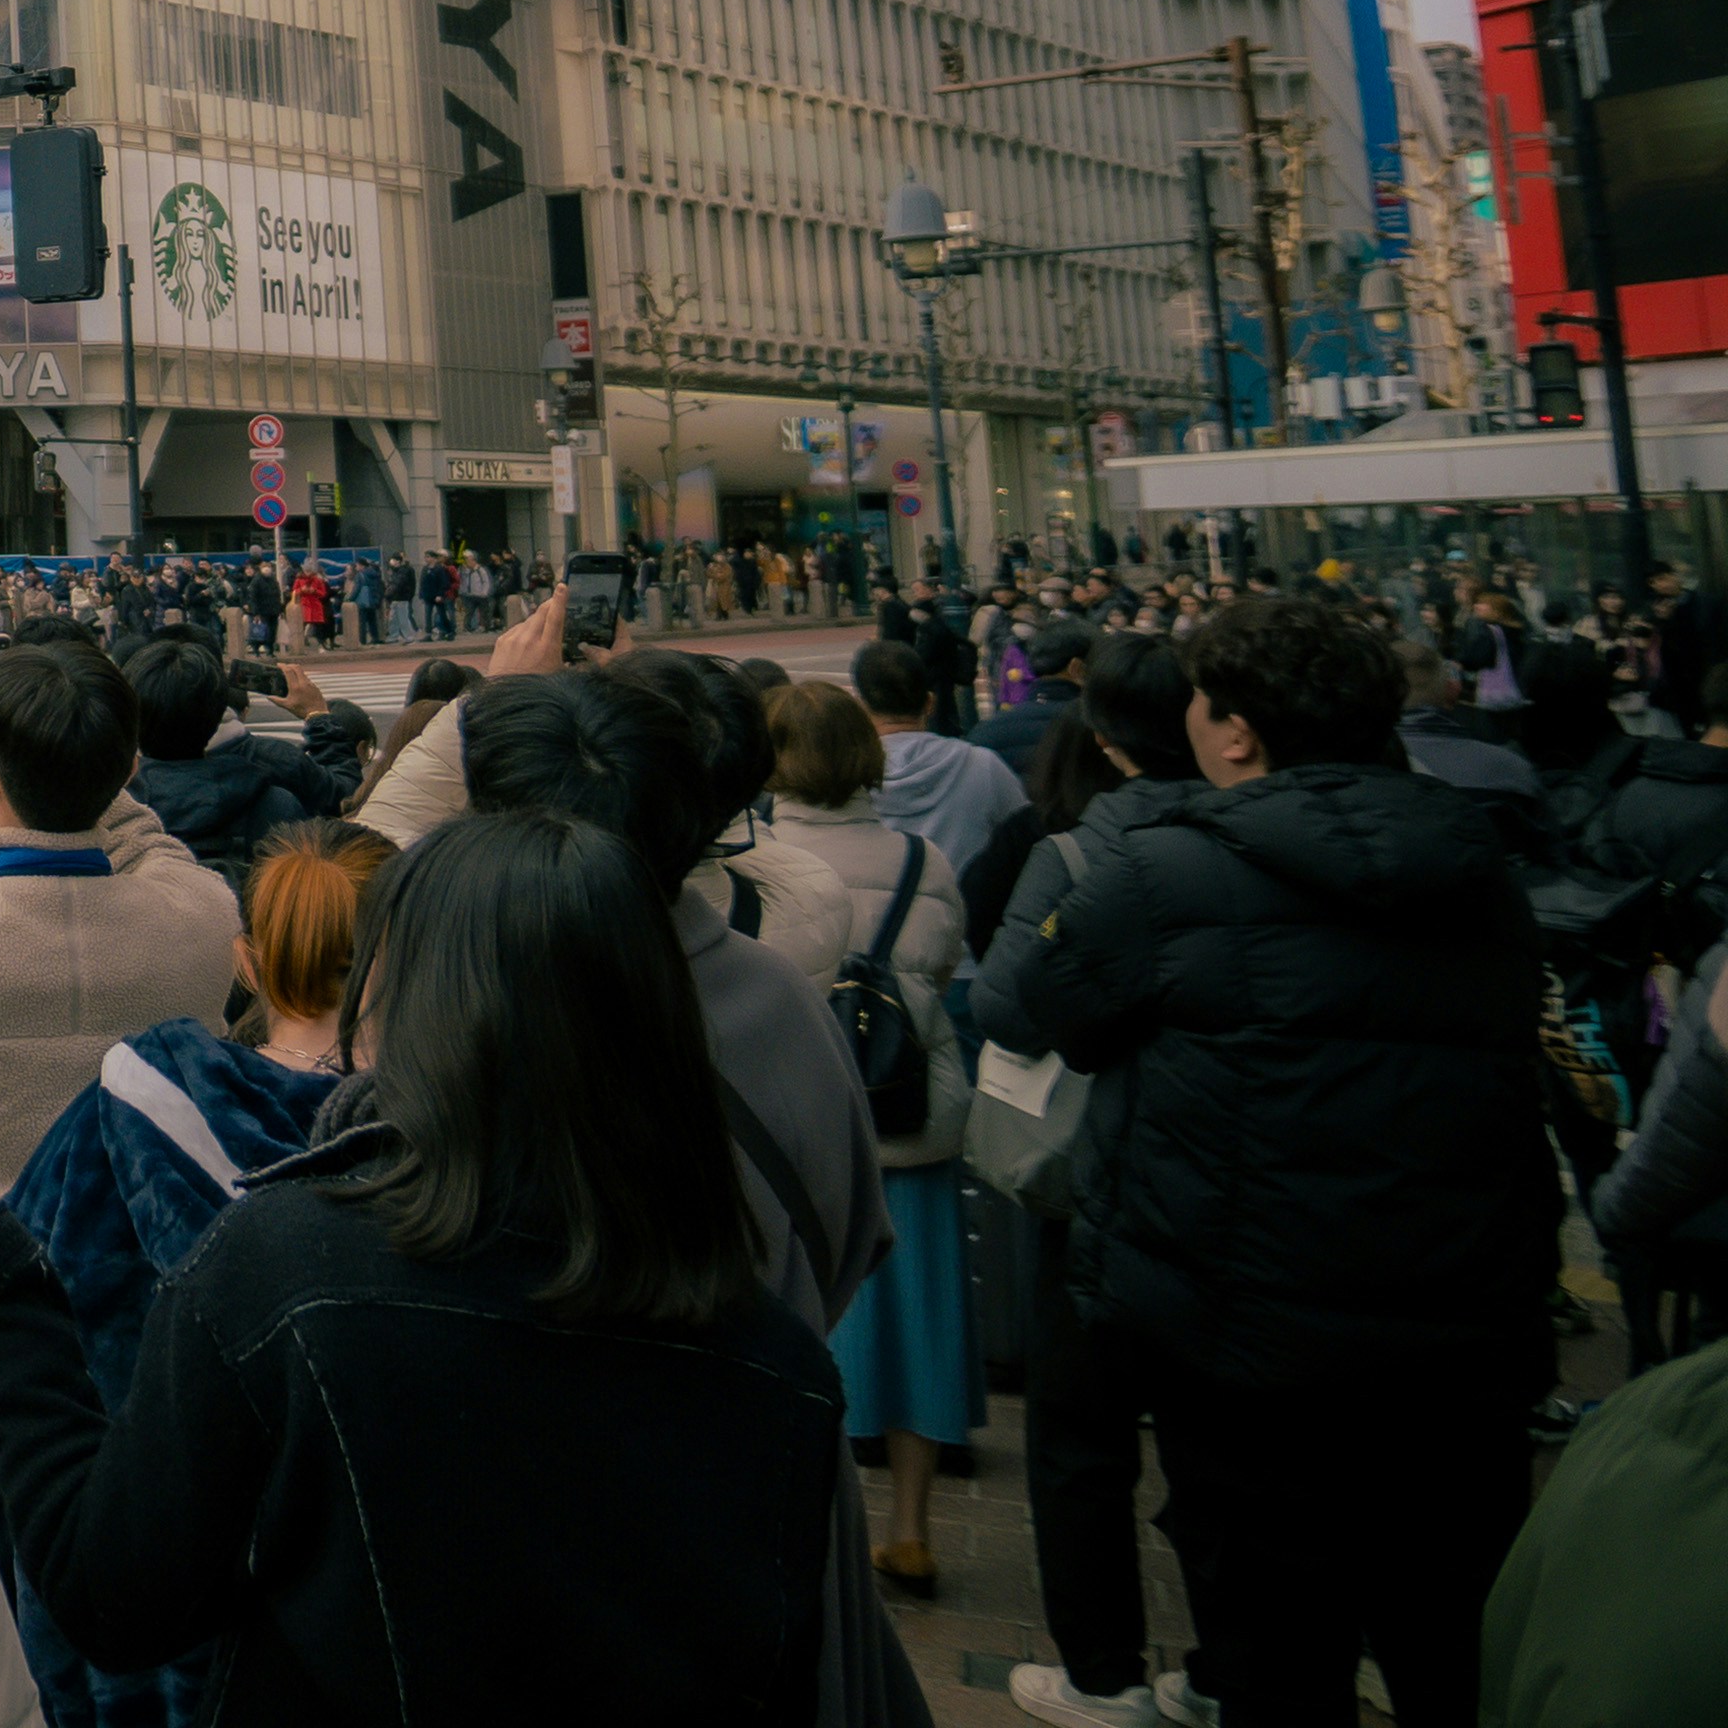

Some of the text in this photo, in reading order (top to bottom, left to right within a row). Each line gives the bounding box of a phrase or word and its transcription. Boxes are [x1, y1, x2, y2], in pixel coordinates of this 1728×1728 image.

[257, 204, 353, 267] See you
[261, 269, 287, 315] in
[560, 322, 588, 353] 本
[447, 460, 511, 481] TSUTAYA
